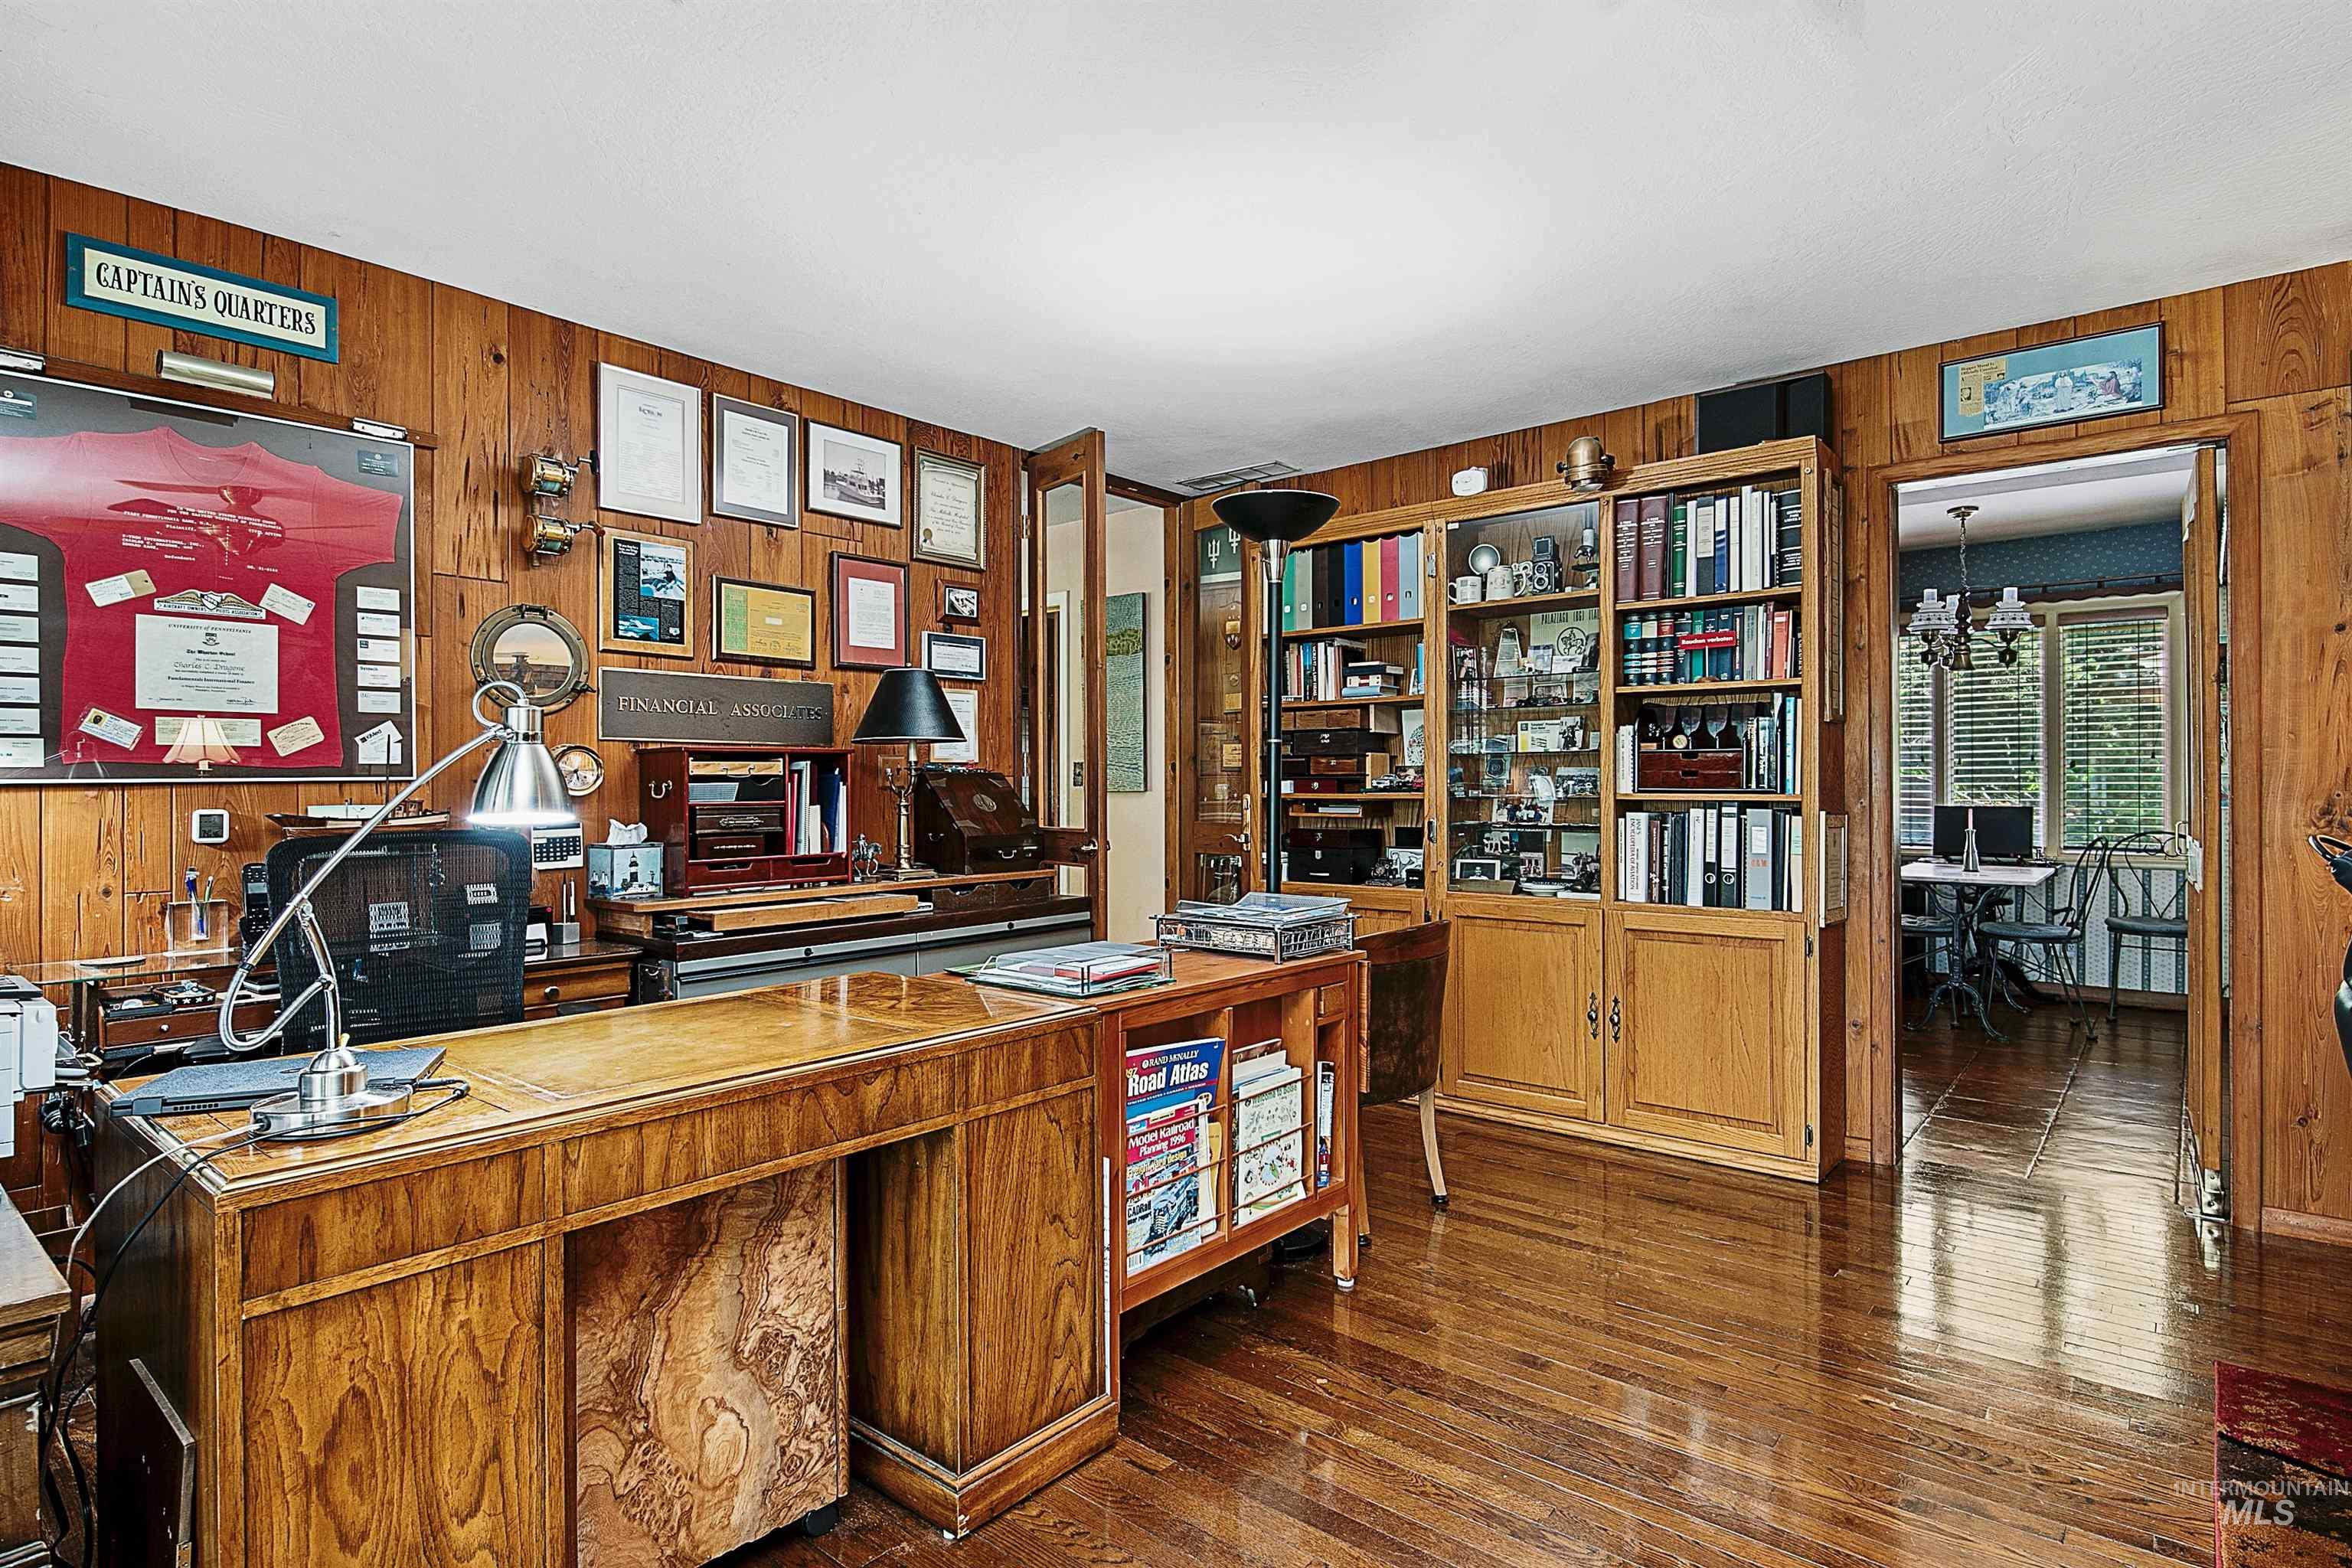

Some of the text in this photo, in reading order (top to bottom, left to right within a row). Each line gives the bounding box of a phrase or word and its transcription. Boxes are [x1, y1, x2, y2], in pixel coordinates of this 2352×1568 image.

[96, 262, 316, 335] CAPTAIN'S QUARTERS
[618, 695, 823, 721] FINANCIAL ASSOCIATES
[1149, 1055, 1168, 1067] RAND
[1128, 1061, 1209, 1097] Road Atlas
[1129, 1131, 1158, 1149] Model
[1159, 1119, 1194, 1138] Railroad
[1139, 1133, 1186, 1158] Planning 1996
[1167, 1150, 1187, 1165] design
